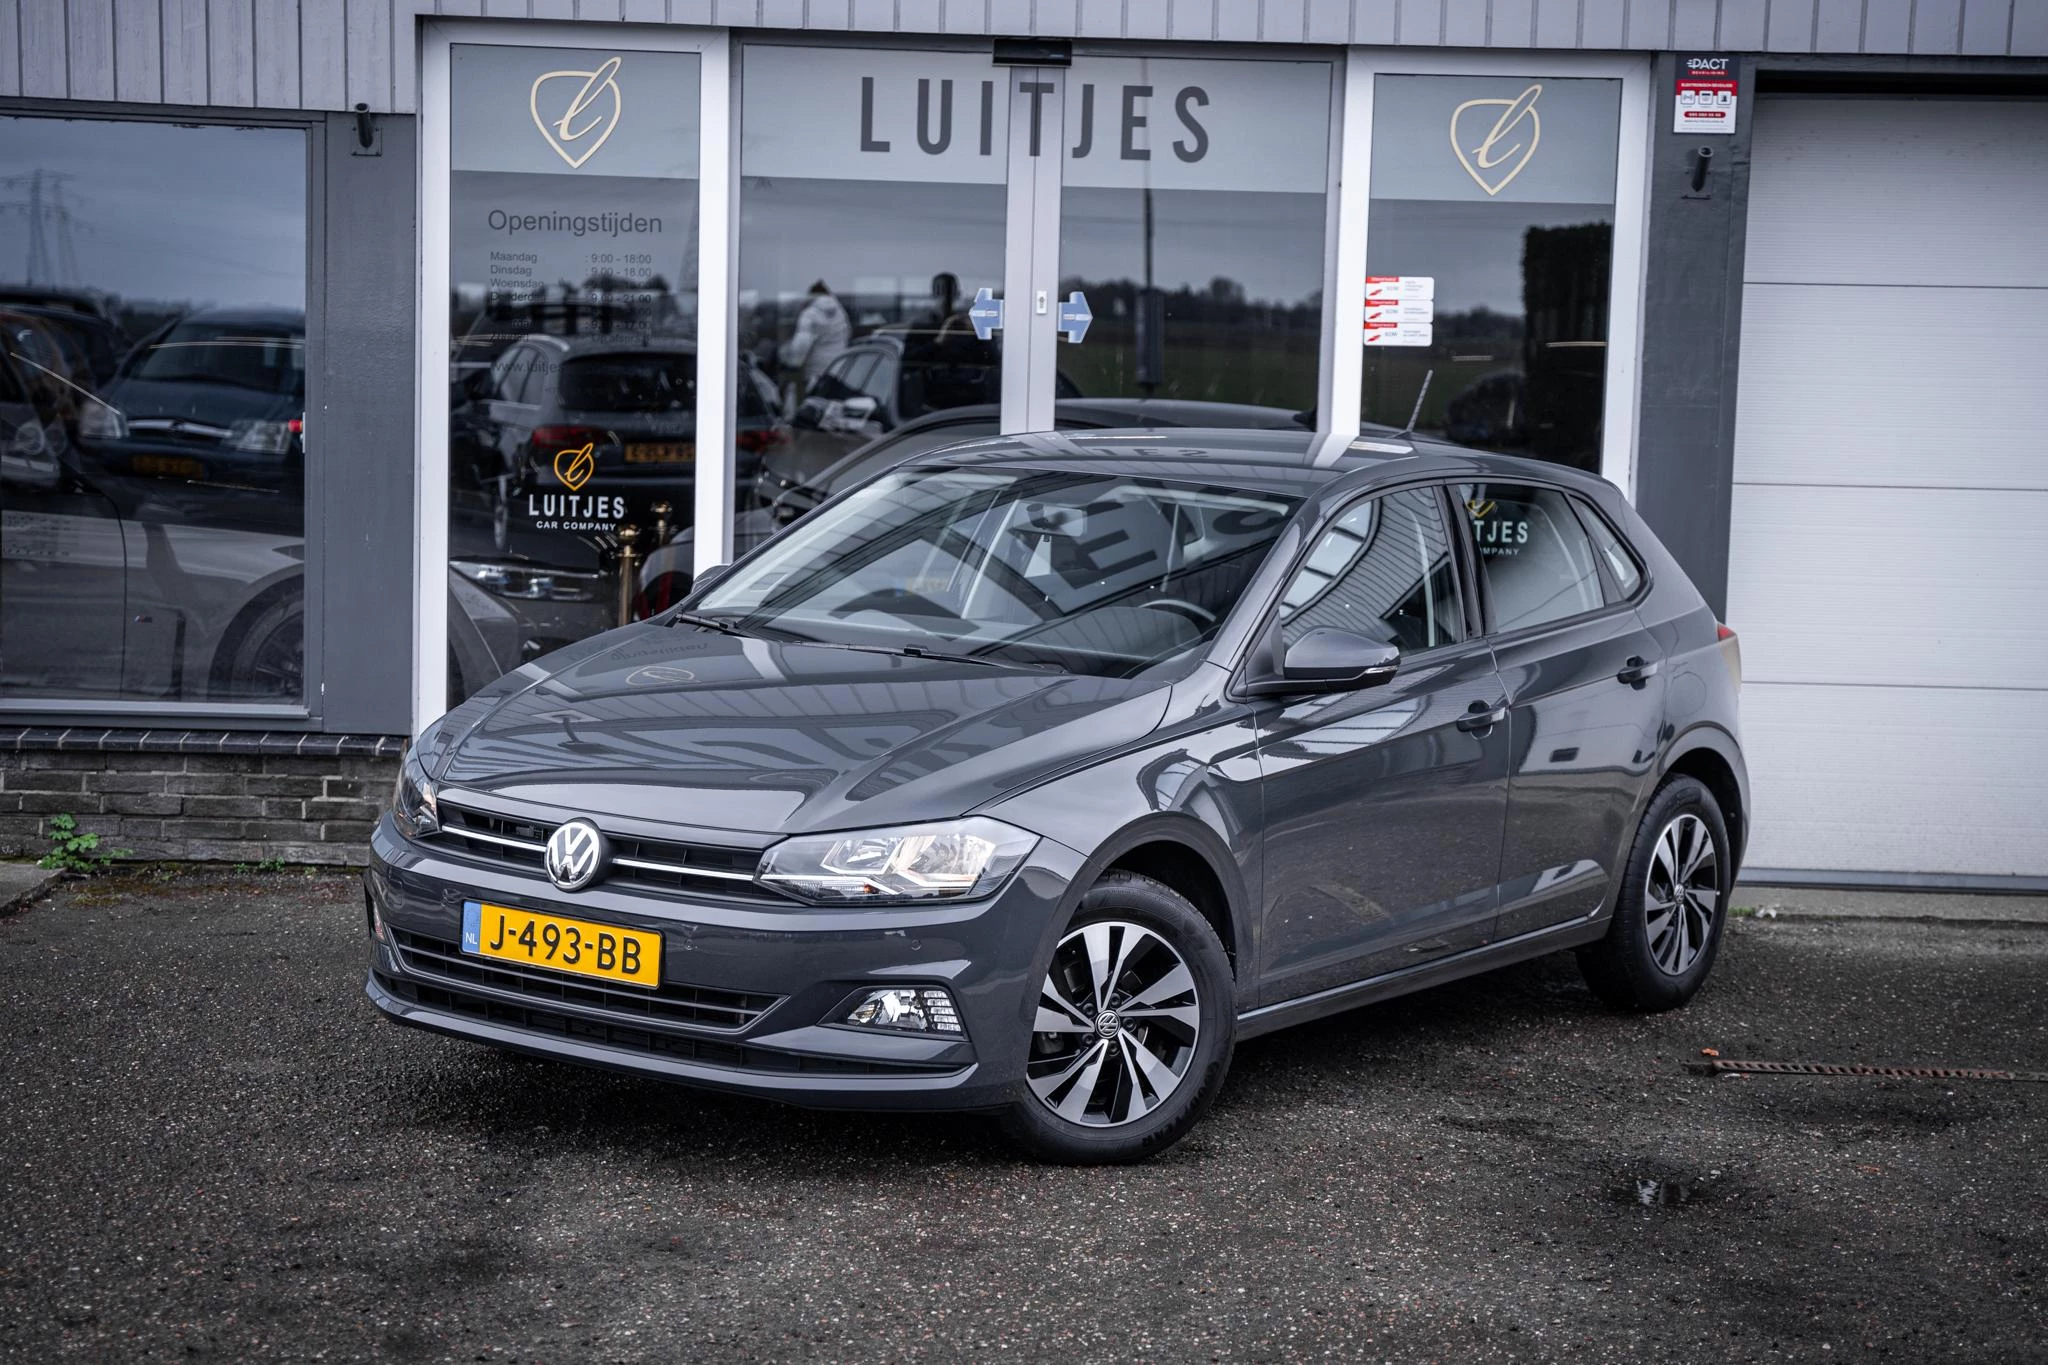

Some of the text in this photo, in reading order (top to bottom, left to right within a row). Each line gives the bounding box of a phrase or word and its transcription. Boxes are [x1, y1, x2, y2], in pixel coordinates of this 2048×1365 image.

[860, 77, 1210, 164] LUITJES
[488, 209, 662, 237] Openingstijden
[490, 251, 537, 264] Maandag
[624, 254, 652, 264] 18:00
[490, 265, 532, 277] Dinsdag
[490, 291, 545, 303] Dderd
[623, 294, 652, 304] 2100
[496, 360, 564, 375] www.luitje
[529, 494, 625, 519] LUITJES
[536, 520, 616, 531] CAR COMPANY
[1474, 520, 1528, 543] TJES
[1480, 547, 1520, 556] MPANY
[465, 932, 478, 944] NL
[489, 915, 641, 975] J-493-BB
